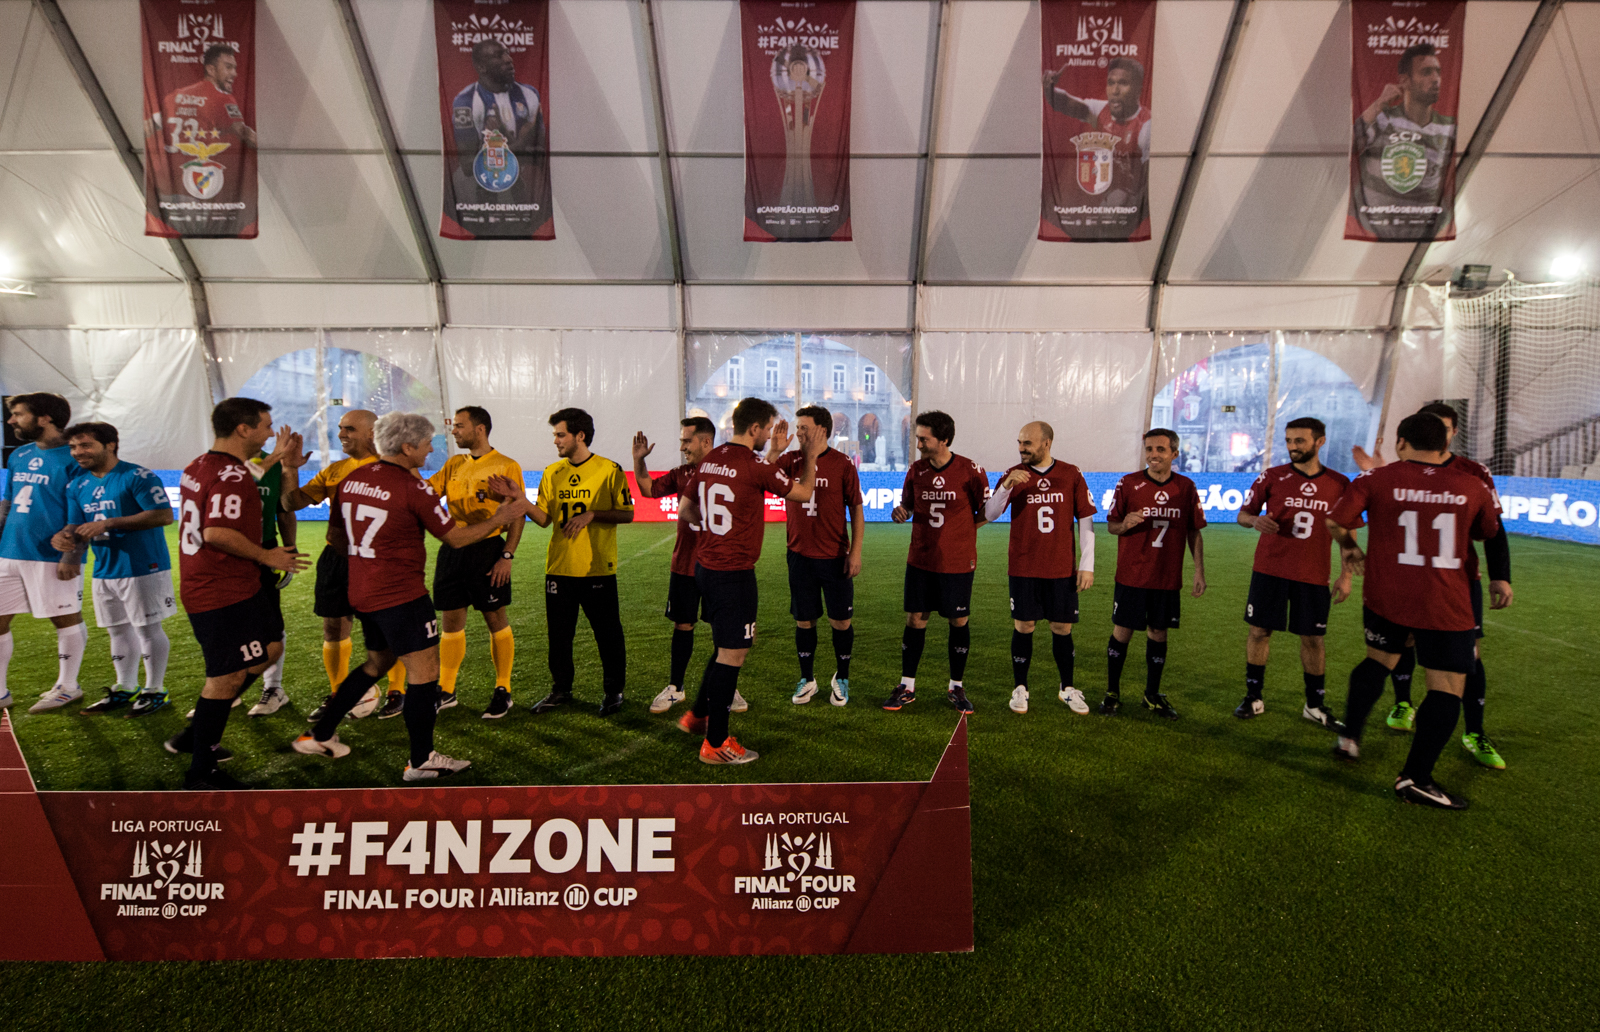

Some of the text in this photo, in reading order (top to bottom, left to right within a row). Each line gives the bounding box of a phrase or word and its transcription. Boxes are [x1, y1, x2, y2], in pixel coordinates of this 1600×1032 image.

[158, 41, 240, 53] FINAL FR
[758, 36, 839, 49] #F4NZONE
[1056, 44, 1138, 56] FINAL FOUR
[1068, 57, 1096, 66] Allianz
[1388, 131, 1422, 144] SCP
[13, 471, 50, 485] aaum
[14, 485, 34, 514] 4
[150, 486, 169, 504] 2
[342, 480, 392, 501] UMinho
[558, 488, 591, 500] aaum
[921, 489, 957, 501] aaum
[1026, 491, 1064, 504] aaum
[1393, 487, 1468, 506] UMinho
[83, 499, 117, 514] aaum
[208, 493, 242, 520] 18
[697, 481, 736, 537] 16
[801, 488, 818, 517] 4
[1284, 496, 1329, 512] aaum
[559, 501, 588, 530] 12
[928, 502, 946, 528] 5
[1036, 505, 1055, 534] 6
[1141, 506, 1181, 519] aaum
[341, 502, 389, 559] 17
[1151, 520, 1170, 548] 7
[1291, 511, 1315, 540] 8
[1397, 510, 1462, 570] 11
[545, 580, 558, 594] 12
[239, 640, 264, 662] 18
[111, 819, 222, 833] LIGA PORTUGAL
[742, 811, 850, 825] LIGA PORTUGAL
[288, 817, 676, 876] #F4NZONE
[100, 882, 225, 901] FINAL FOUR
[734, 875, 856, 894] FINAL FOUR
[323, 886, 638, 910] FINAL FOUR Allianz CUP
[751, 897, 840, 910] Allianz CUP
[117, 904, 208, 917] Allianz CUP
